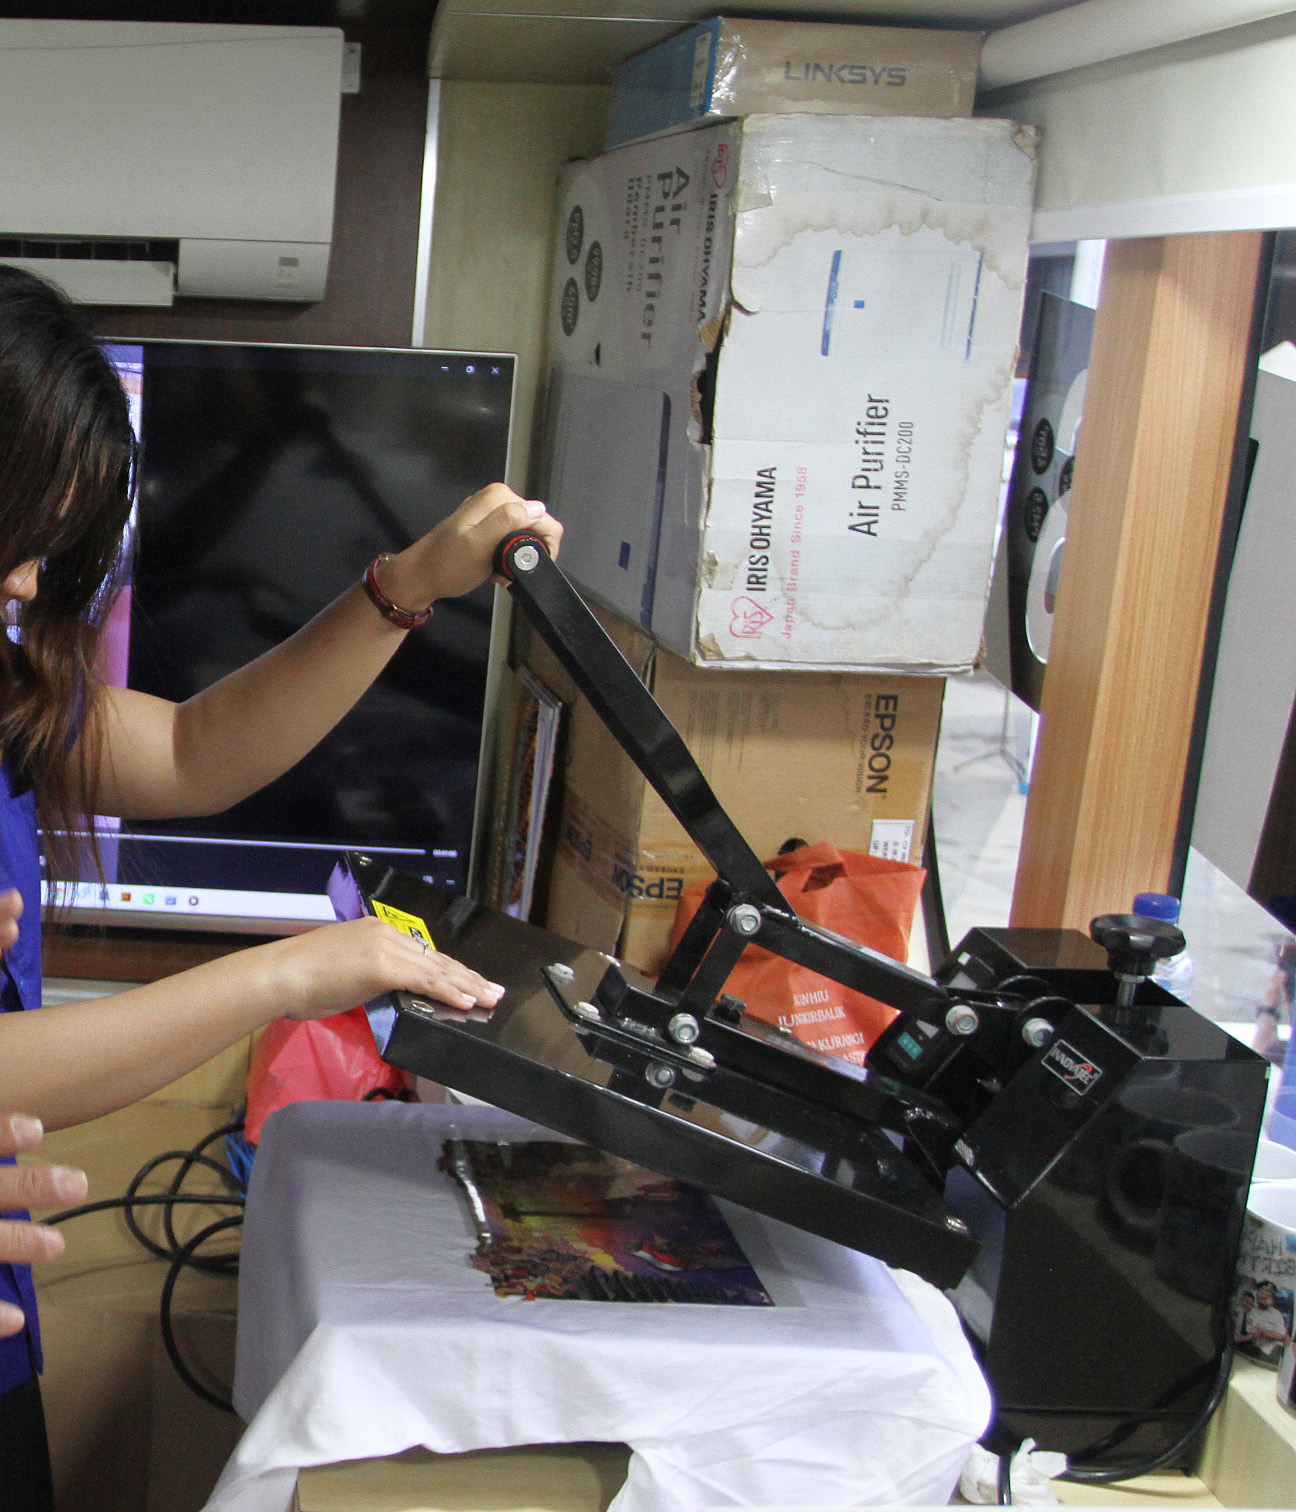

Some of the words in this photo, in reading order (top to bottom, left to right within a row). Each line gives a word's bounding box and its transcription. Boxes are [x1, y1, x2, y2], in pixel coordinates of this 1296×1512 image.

[784, 61, 907, 87] LINKSYS
[669, 166, 691, 234] Air
[705, 192, 718, 232] IRIS
[640, 171, 674, 349] Purifier
[697, 237, 714, 322] OHYAMA
[851, 393, 890, 490] Purifier
[795, 466, 807, 499] 1958
[891, 421, 914, 511] PMMS-DC200
[750, 466, 777, 550] OHYAMA
[790, 505, 804, 543] Since
[847, 500, 880, 537] Air
[746, 554, 770, 592] IRIS
[787, 550, 800, 592] Brand
[782, 598, 796, 640] Japan
[865, 693, 899, 793] EPSON
